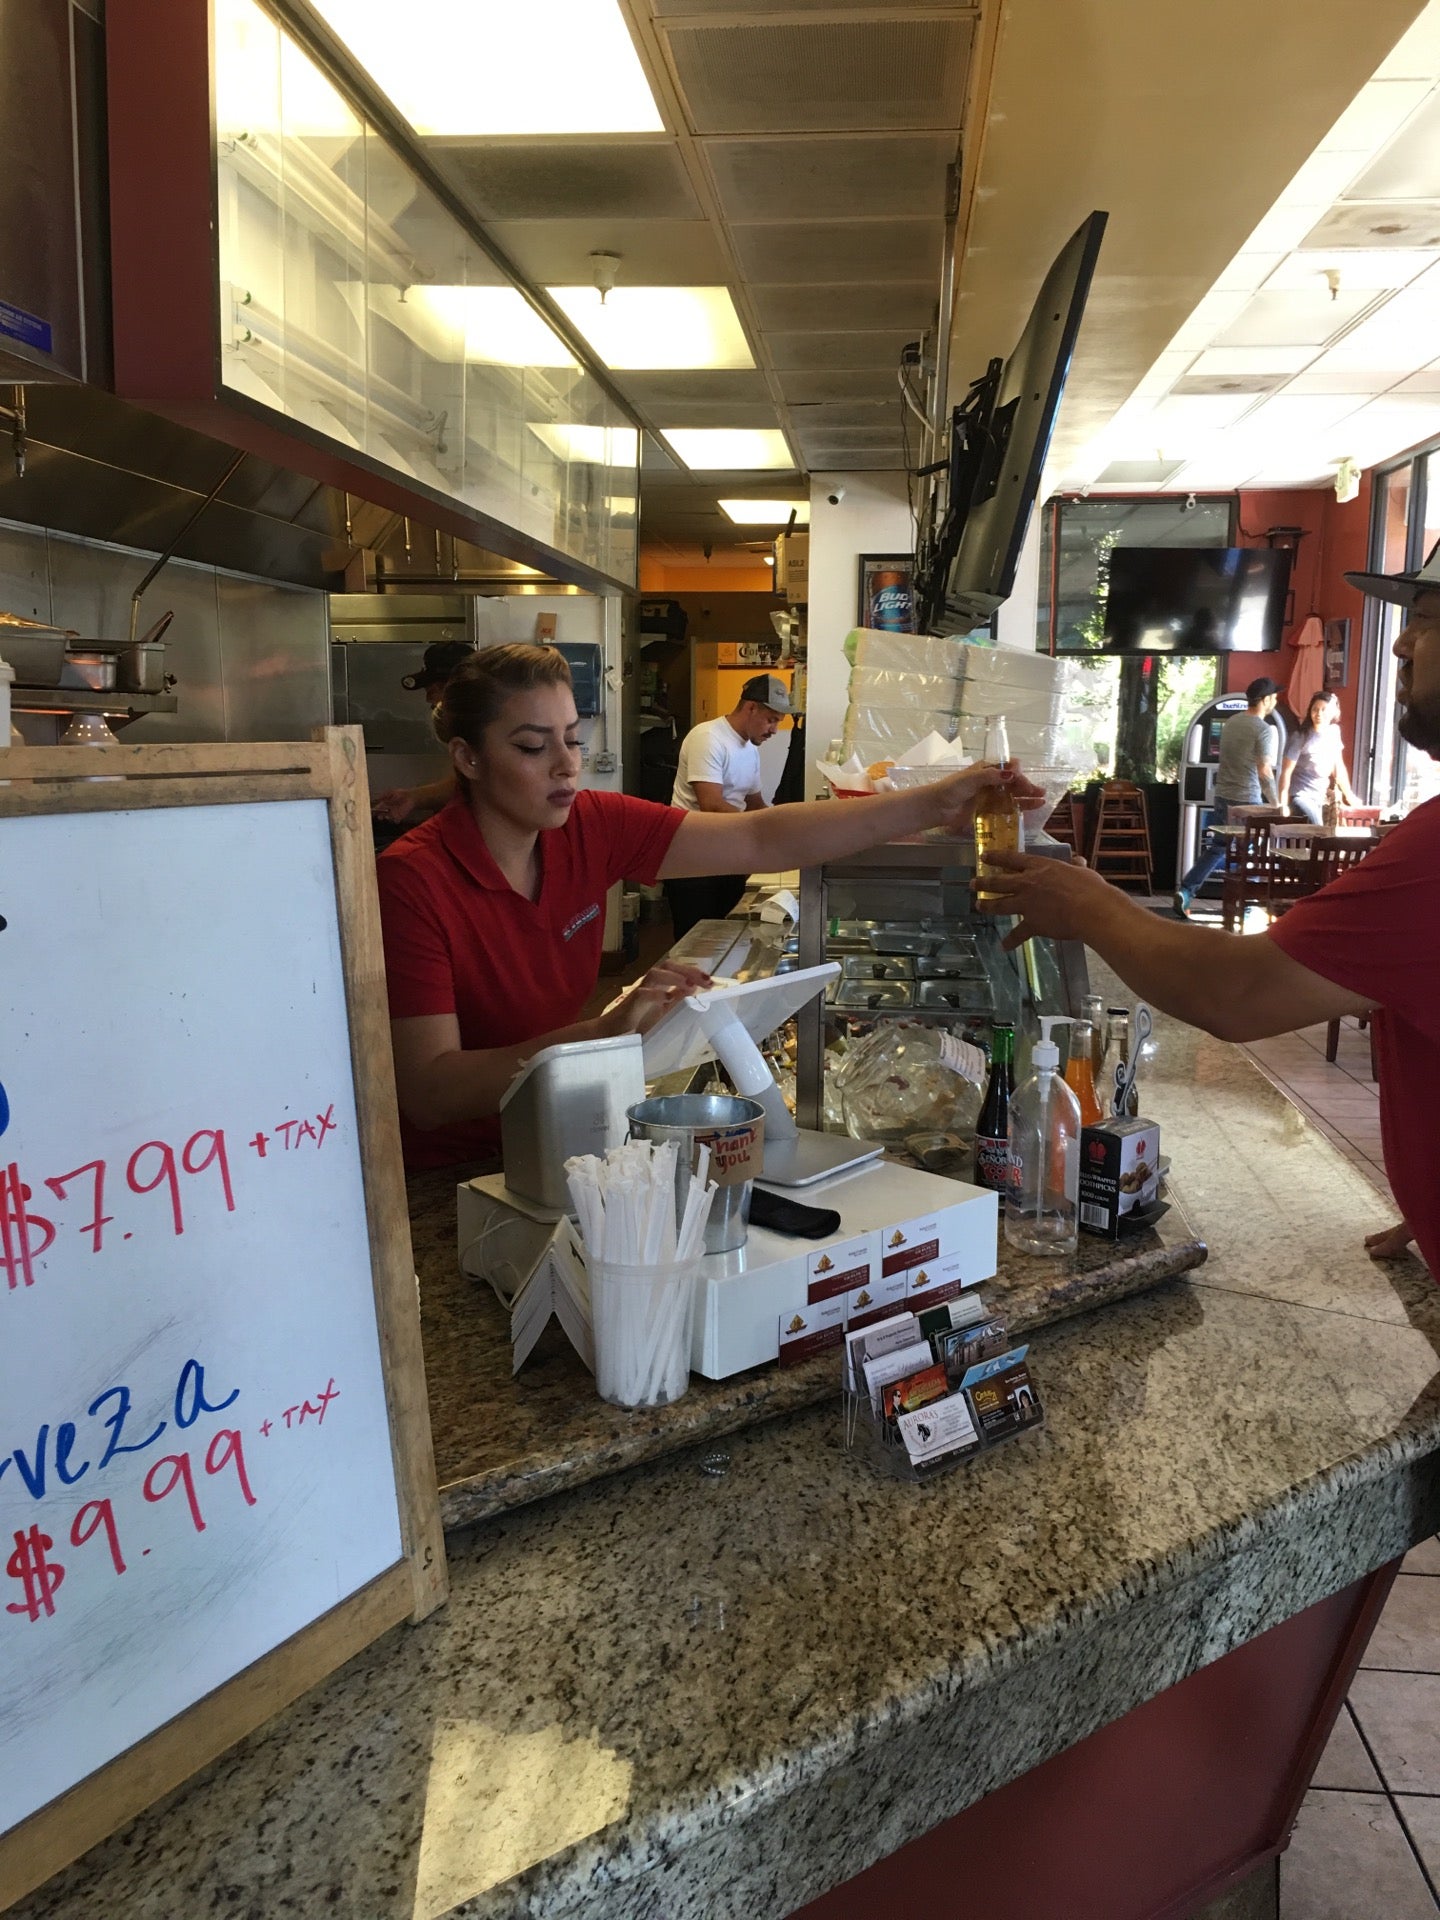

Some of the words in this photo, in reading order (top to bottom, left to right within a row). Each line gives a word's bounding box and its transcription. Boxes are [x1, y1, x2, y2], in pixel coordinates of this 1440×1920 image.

[878, 592, 909, 603] BUD
[0, 1129, 236, 1289] $7.99
[1079, 1180, 1117, 1193] OOTHPICKS
[6, 1429, 257, 1622] $9.99
